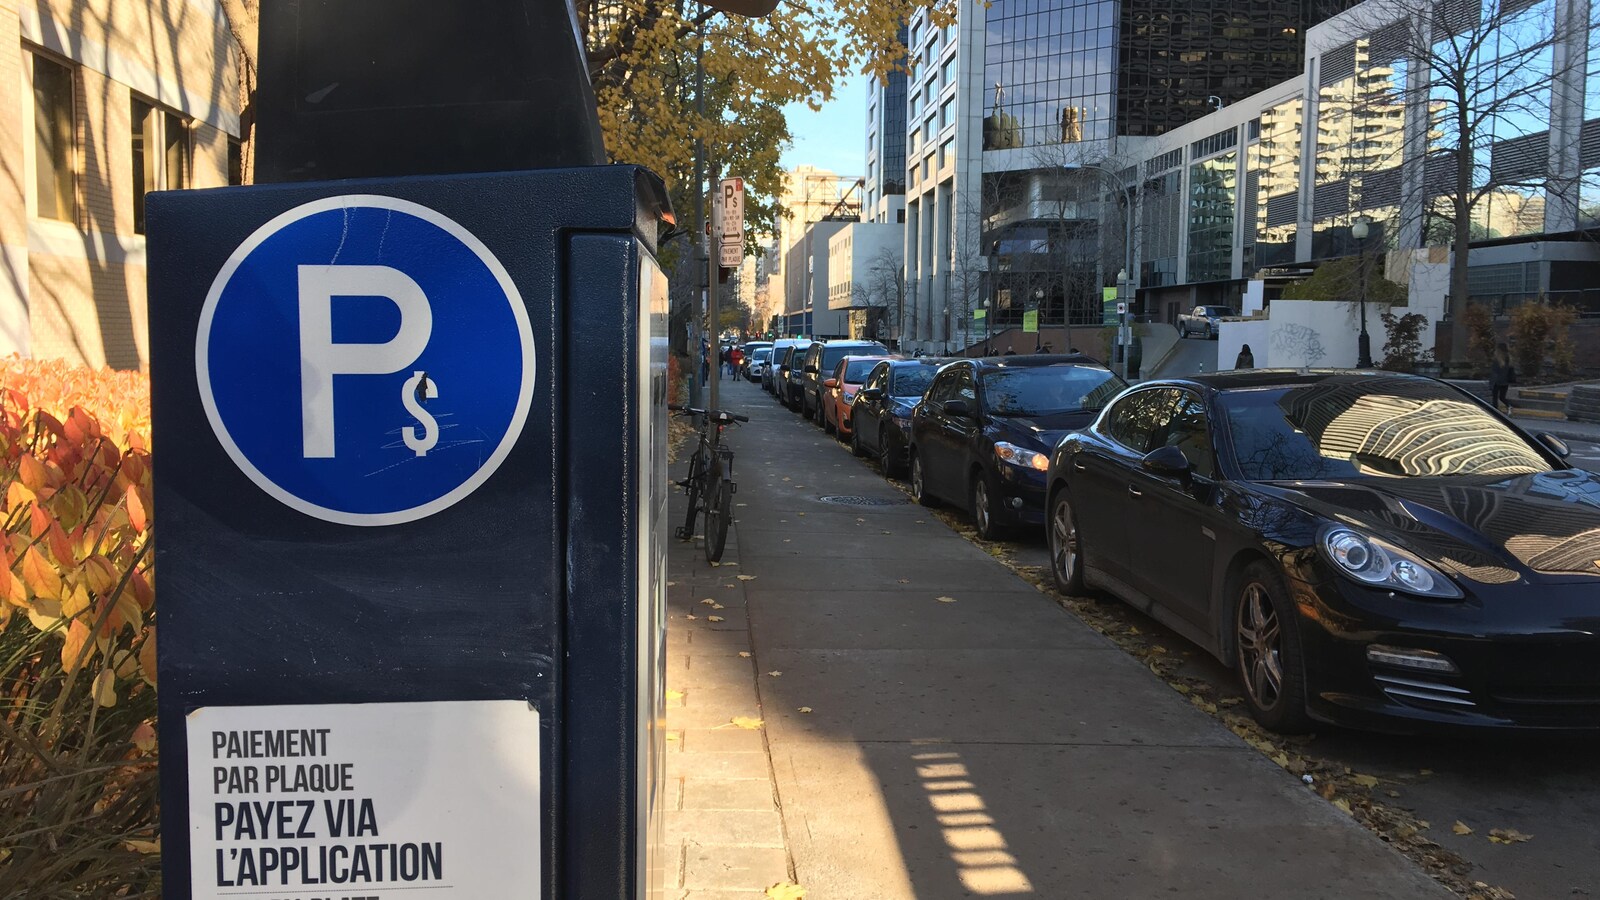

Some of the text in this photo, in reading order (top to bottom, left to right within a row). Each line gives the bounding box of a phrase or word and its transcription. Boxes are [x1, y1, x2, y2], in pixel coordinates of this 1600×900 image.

[212, 729, 331, 759] PAIEMENT
[213, 763, 354, 795] PAR PLAQUE
[214, 798, 379, 841] PAYEZ VIA
[215, 842, 443, 887] L'APPLICATION
